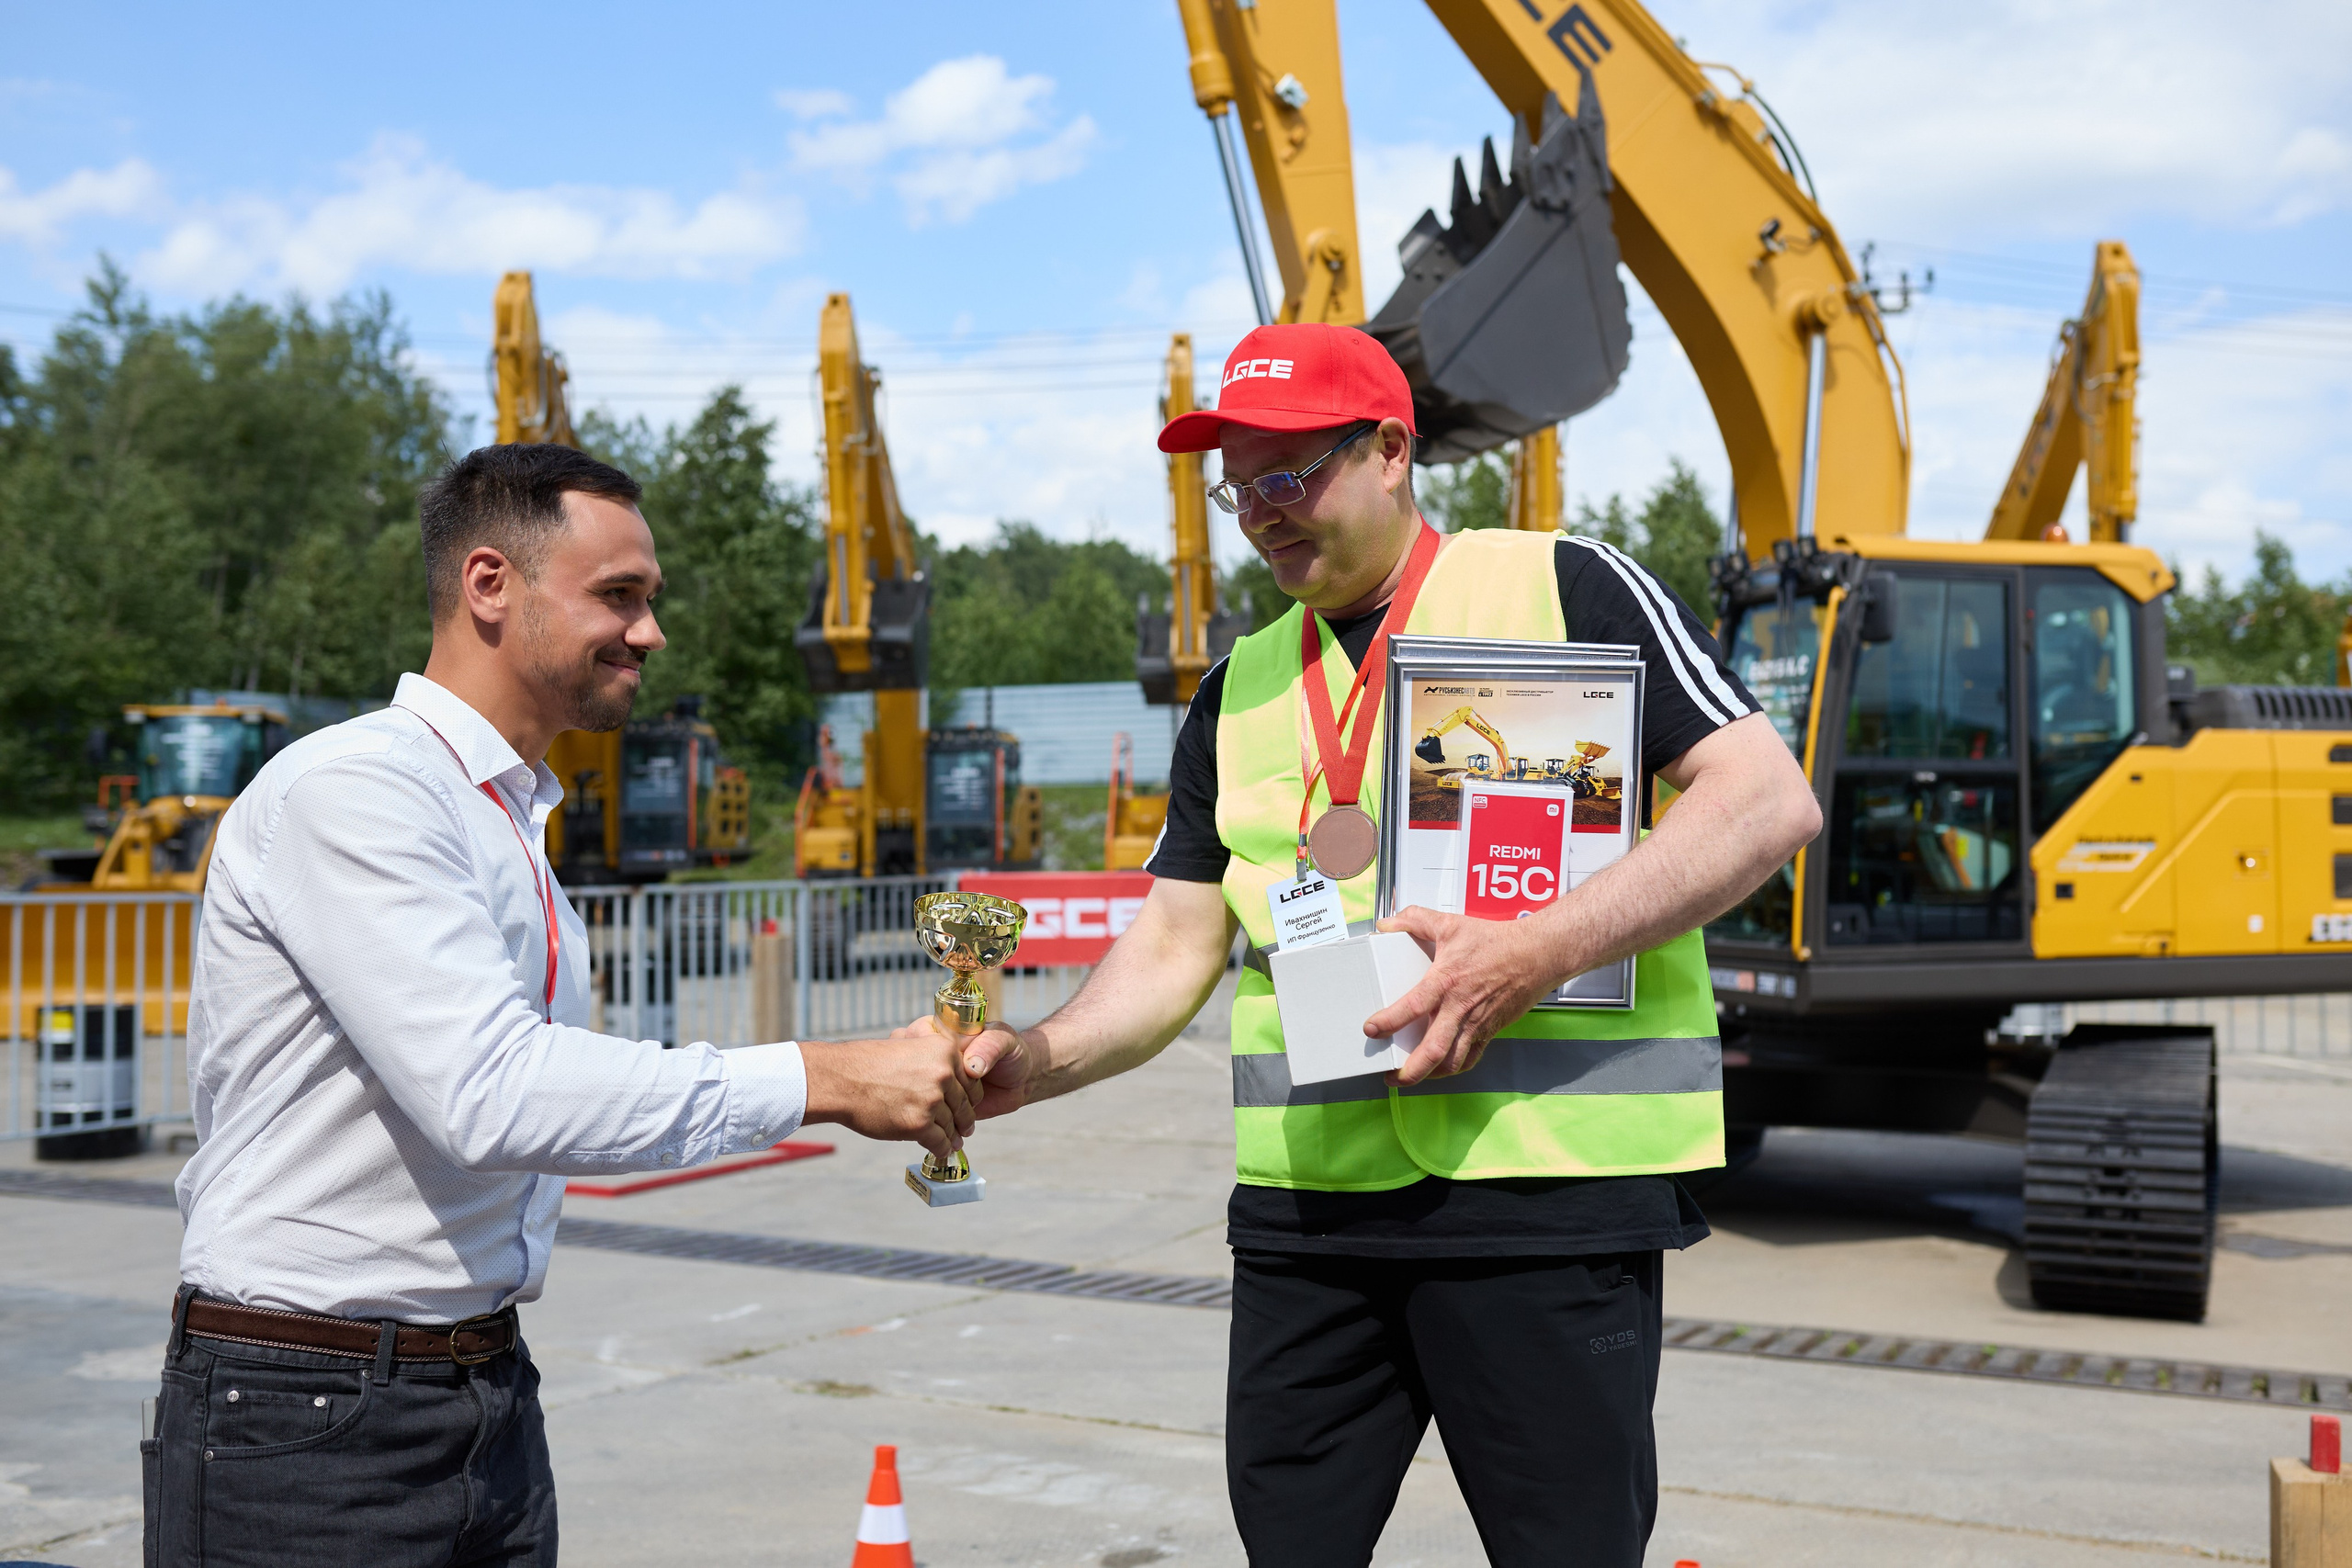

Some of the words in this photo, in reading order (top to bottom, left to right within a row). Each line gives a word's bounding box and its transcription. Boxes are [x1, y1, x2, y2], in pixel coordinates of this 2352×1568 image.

[1514, 0, 1612, 75] E
[1222, 358, 1294, 389] LGCE
[1583, 691, 1614, 699] LGCE
[1489, 844, 1541, 860] REDMI
[1279, 880, 1325, 903] LGCE
[1472, 863, 1555, 901] 15C
[1017, 897, 1148, 939] GCE
[1284, 908, 1328, 926] Ивахнишин
[1295, 916, 1322, 931] Сергей
[1287, 935, 1296, 944] ИП
[1296, 923, 1336, 940] Французенко
[1606, 1329, 1635, 1344] YDS
[1608, 1340, 1637, 1352] YADESHI
